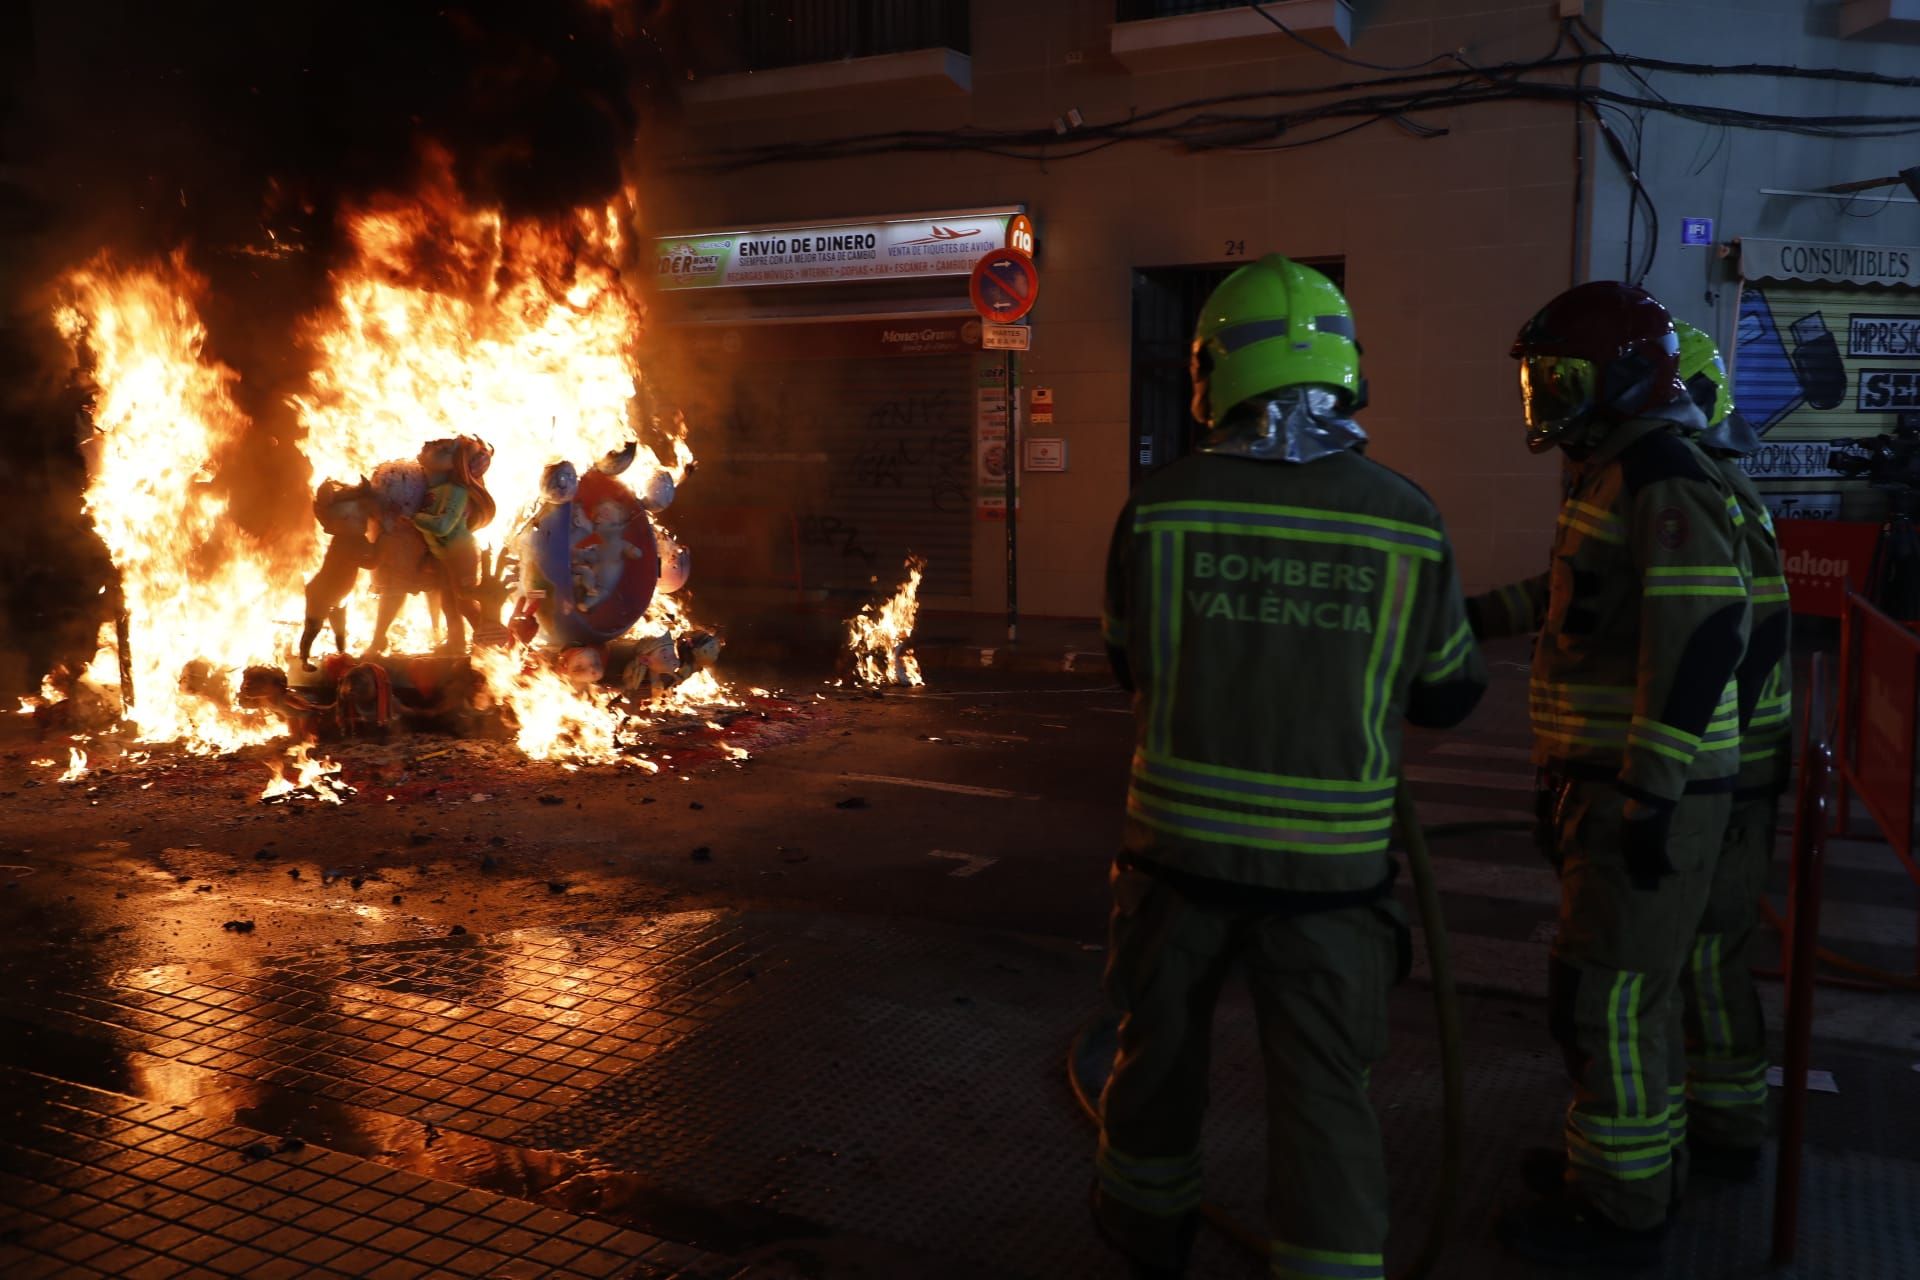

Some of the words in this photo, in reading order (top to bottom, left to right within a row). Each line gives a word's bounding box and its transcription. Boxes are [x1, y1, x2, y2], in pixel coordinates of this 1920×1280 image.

[739, 236, 786, 257] ENVÍO
[791, 238, 811, 254] DE
[816, 233, 876, 252] DINERO
[1012, 221, 1031, 253] ria
[1224, 240, 1244, 256] 24
[693, 256, 719, 265] MONEY
[739, 256, 768, 267] SIEMPRE
[769, 255, 783, 266] CON
[785, 254, 793, 265] LA
[794, 253, 817, 264] MEJOR
[818, 251, 836, 263] TASA
[837, 251, 845, 262] DE
[847, 249, 877, 261] CAMBIO
[888, 246, 910, 257] VENTA
[912, 245, 921, 256] DE
[923, 243, 958, 255] TIQUETES
[960, 242, 969, 253] DE
[727, 271, 763, 282] RECARGAS
[936, 258, 966, 271] CAMBIO
[1781, 246, 1910, 278] CONSUMIBLES
[882, 328, 957, 344] MoneyGram
[1866, 374, 1920, 407] SE
[1738, 445, 1800, 475] OCOPIAS
[1193, 551, 1377, 593] BOMBERS
[1187, 588, 1373, 634] VALÈNCIA
